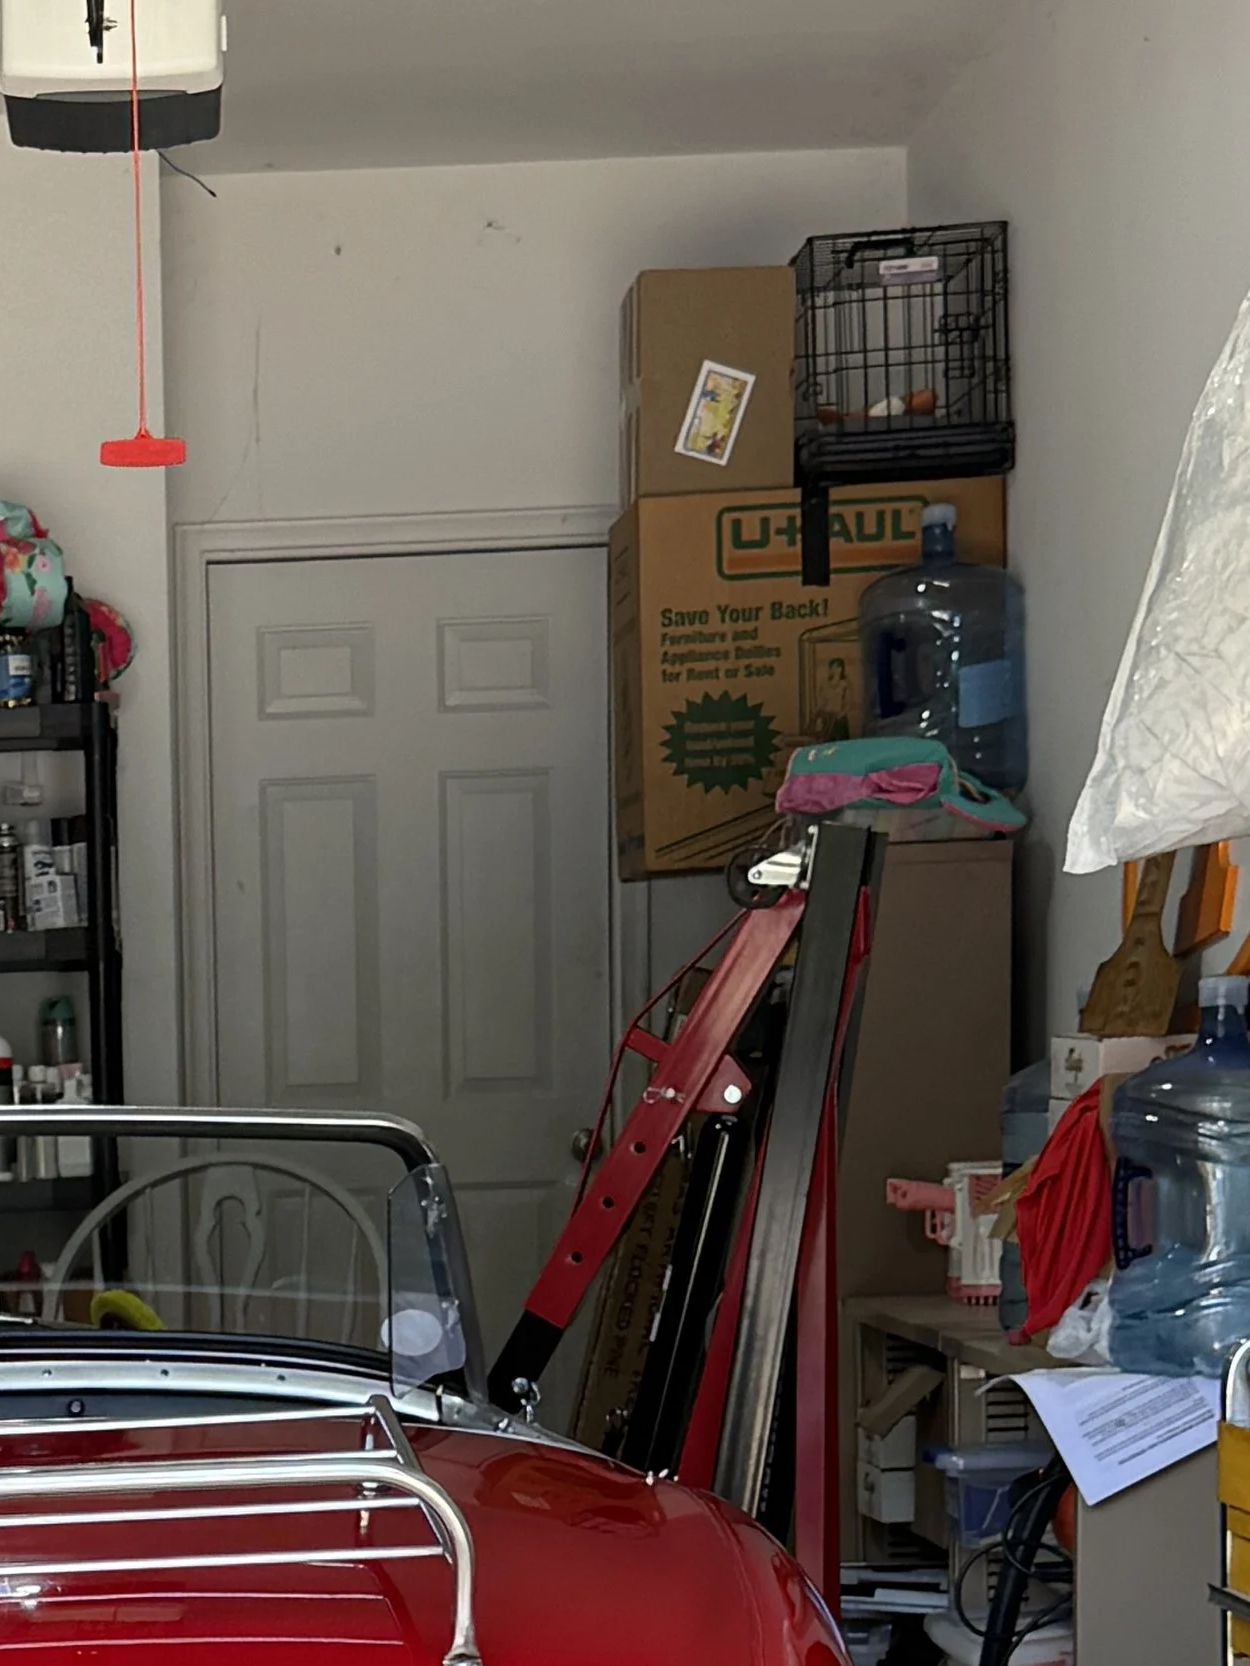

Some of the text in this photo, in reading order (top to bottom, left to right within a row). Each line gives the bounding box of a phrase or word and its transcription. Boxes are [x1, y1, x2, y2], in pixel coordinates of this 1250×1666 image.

[660, 599, 829, 627] Save Your Back!
[732, 627, 759, 642] and
[661, 664, 775, 683] for Rent or Sale
